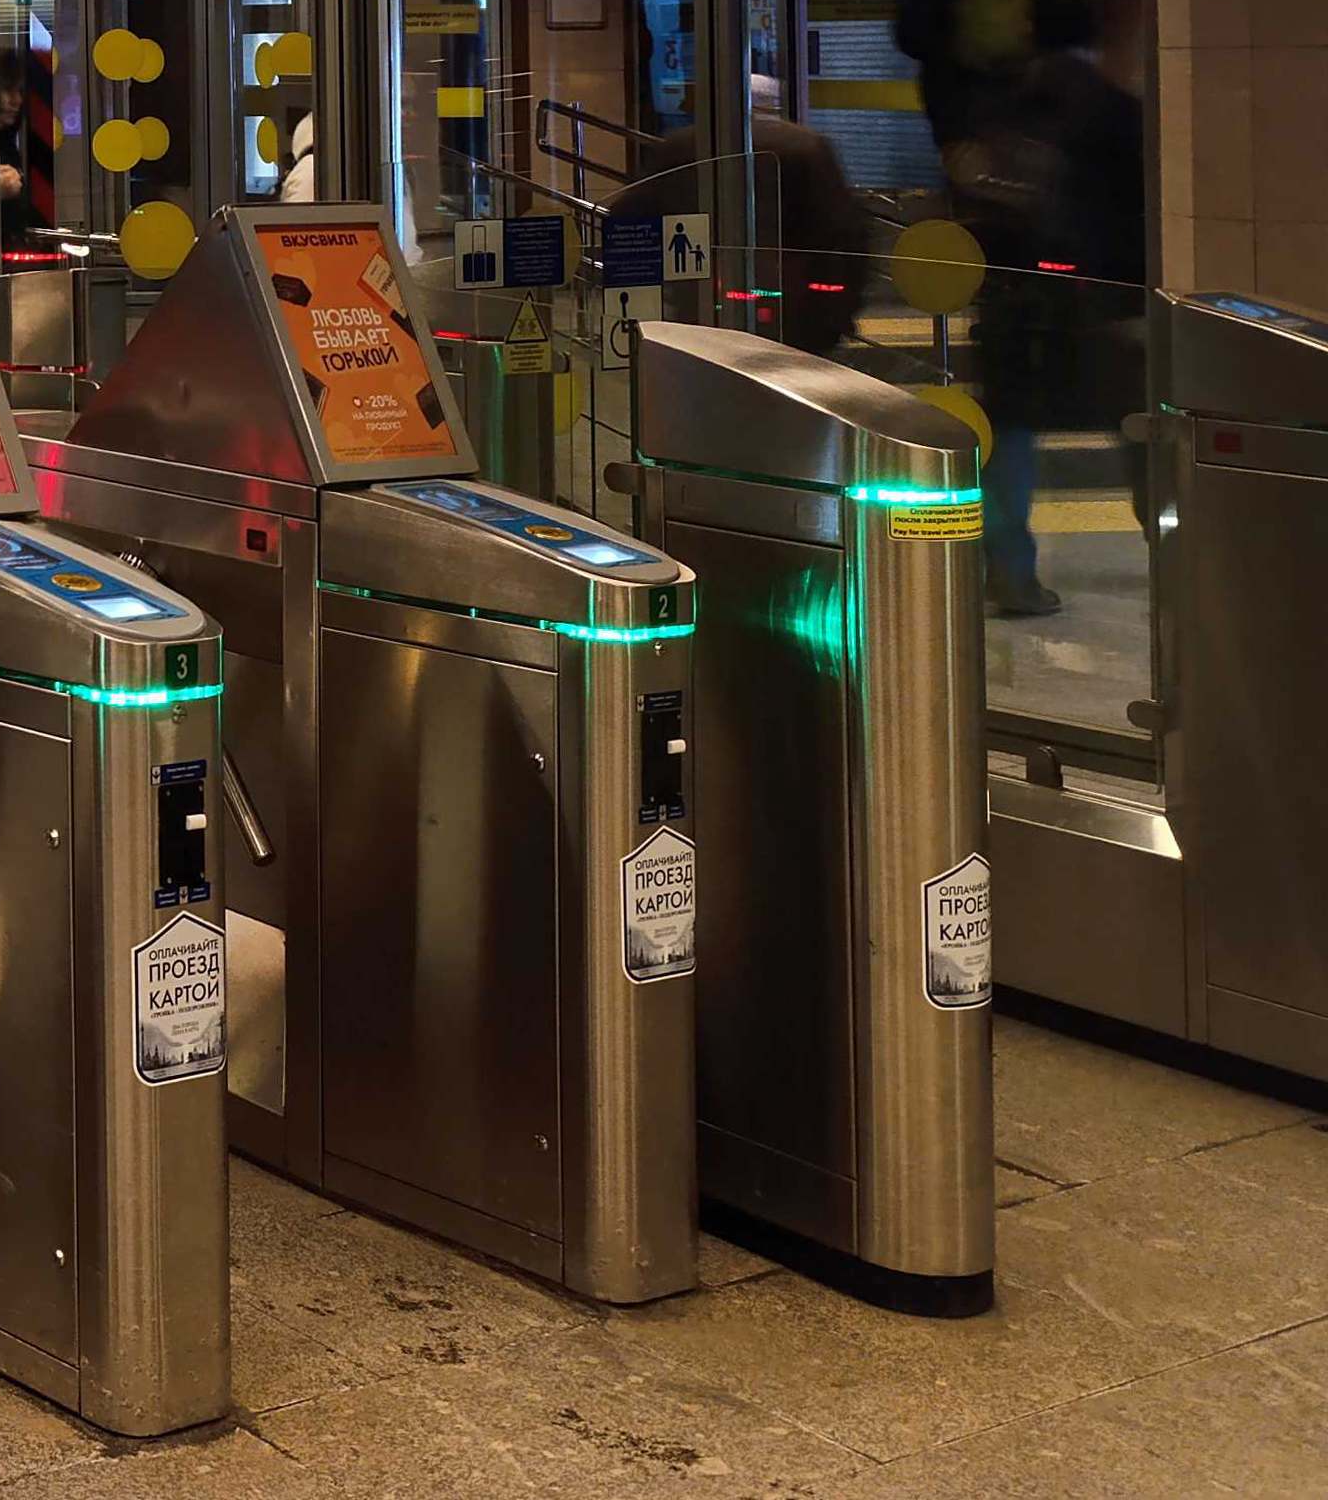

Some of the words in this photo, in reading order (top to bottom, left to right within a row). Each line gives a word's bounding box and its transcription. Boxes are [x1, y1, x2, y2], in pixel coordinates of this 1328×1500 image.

[281, 233, 358, 248] ВКУСВИЛЛ
[311, 307, 383, 328] ЛЮБОВЬ
[320, 342, 399, 373] ГОРЬКОЙ
[659, 594, 669, 619] 2
[175, 652, 189, 679] 3
[634, 851, 693, 871] ОПЛАЧИВАЙТЕ
[635, 864, 693, 891] ПРОЕЗД
[635, 884, 693, 916] КАРТОЙ
[149, 939, 219, 962] ОПЛАЧИВАЙТЕ
[149, 953, 220, 983] ПРОЕЗД
[149, 976, 219, 1011] КАРТОЙ
